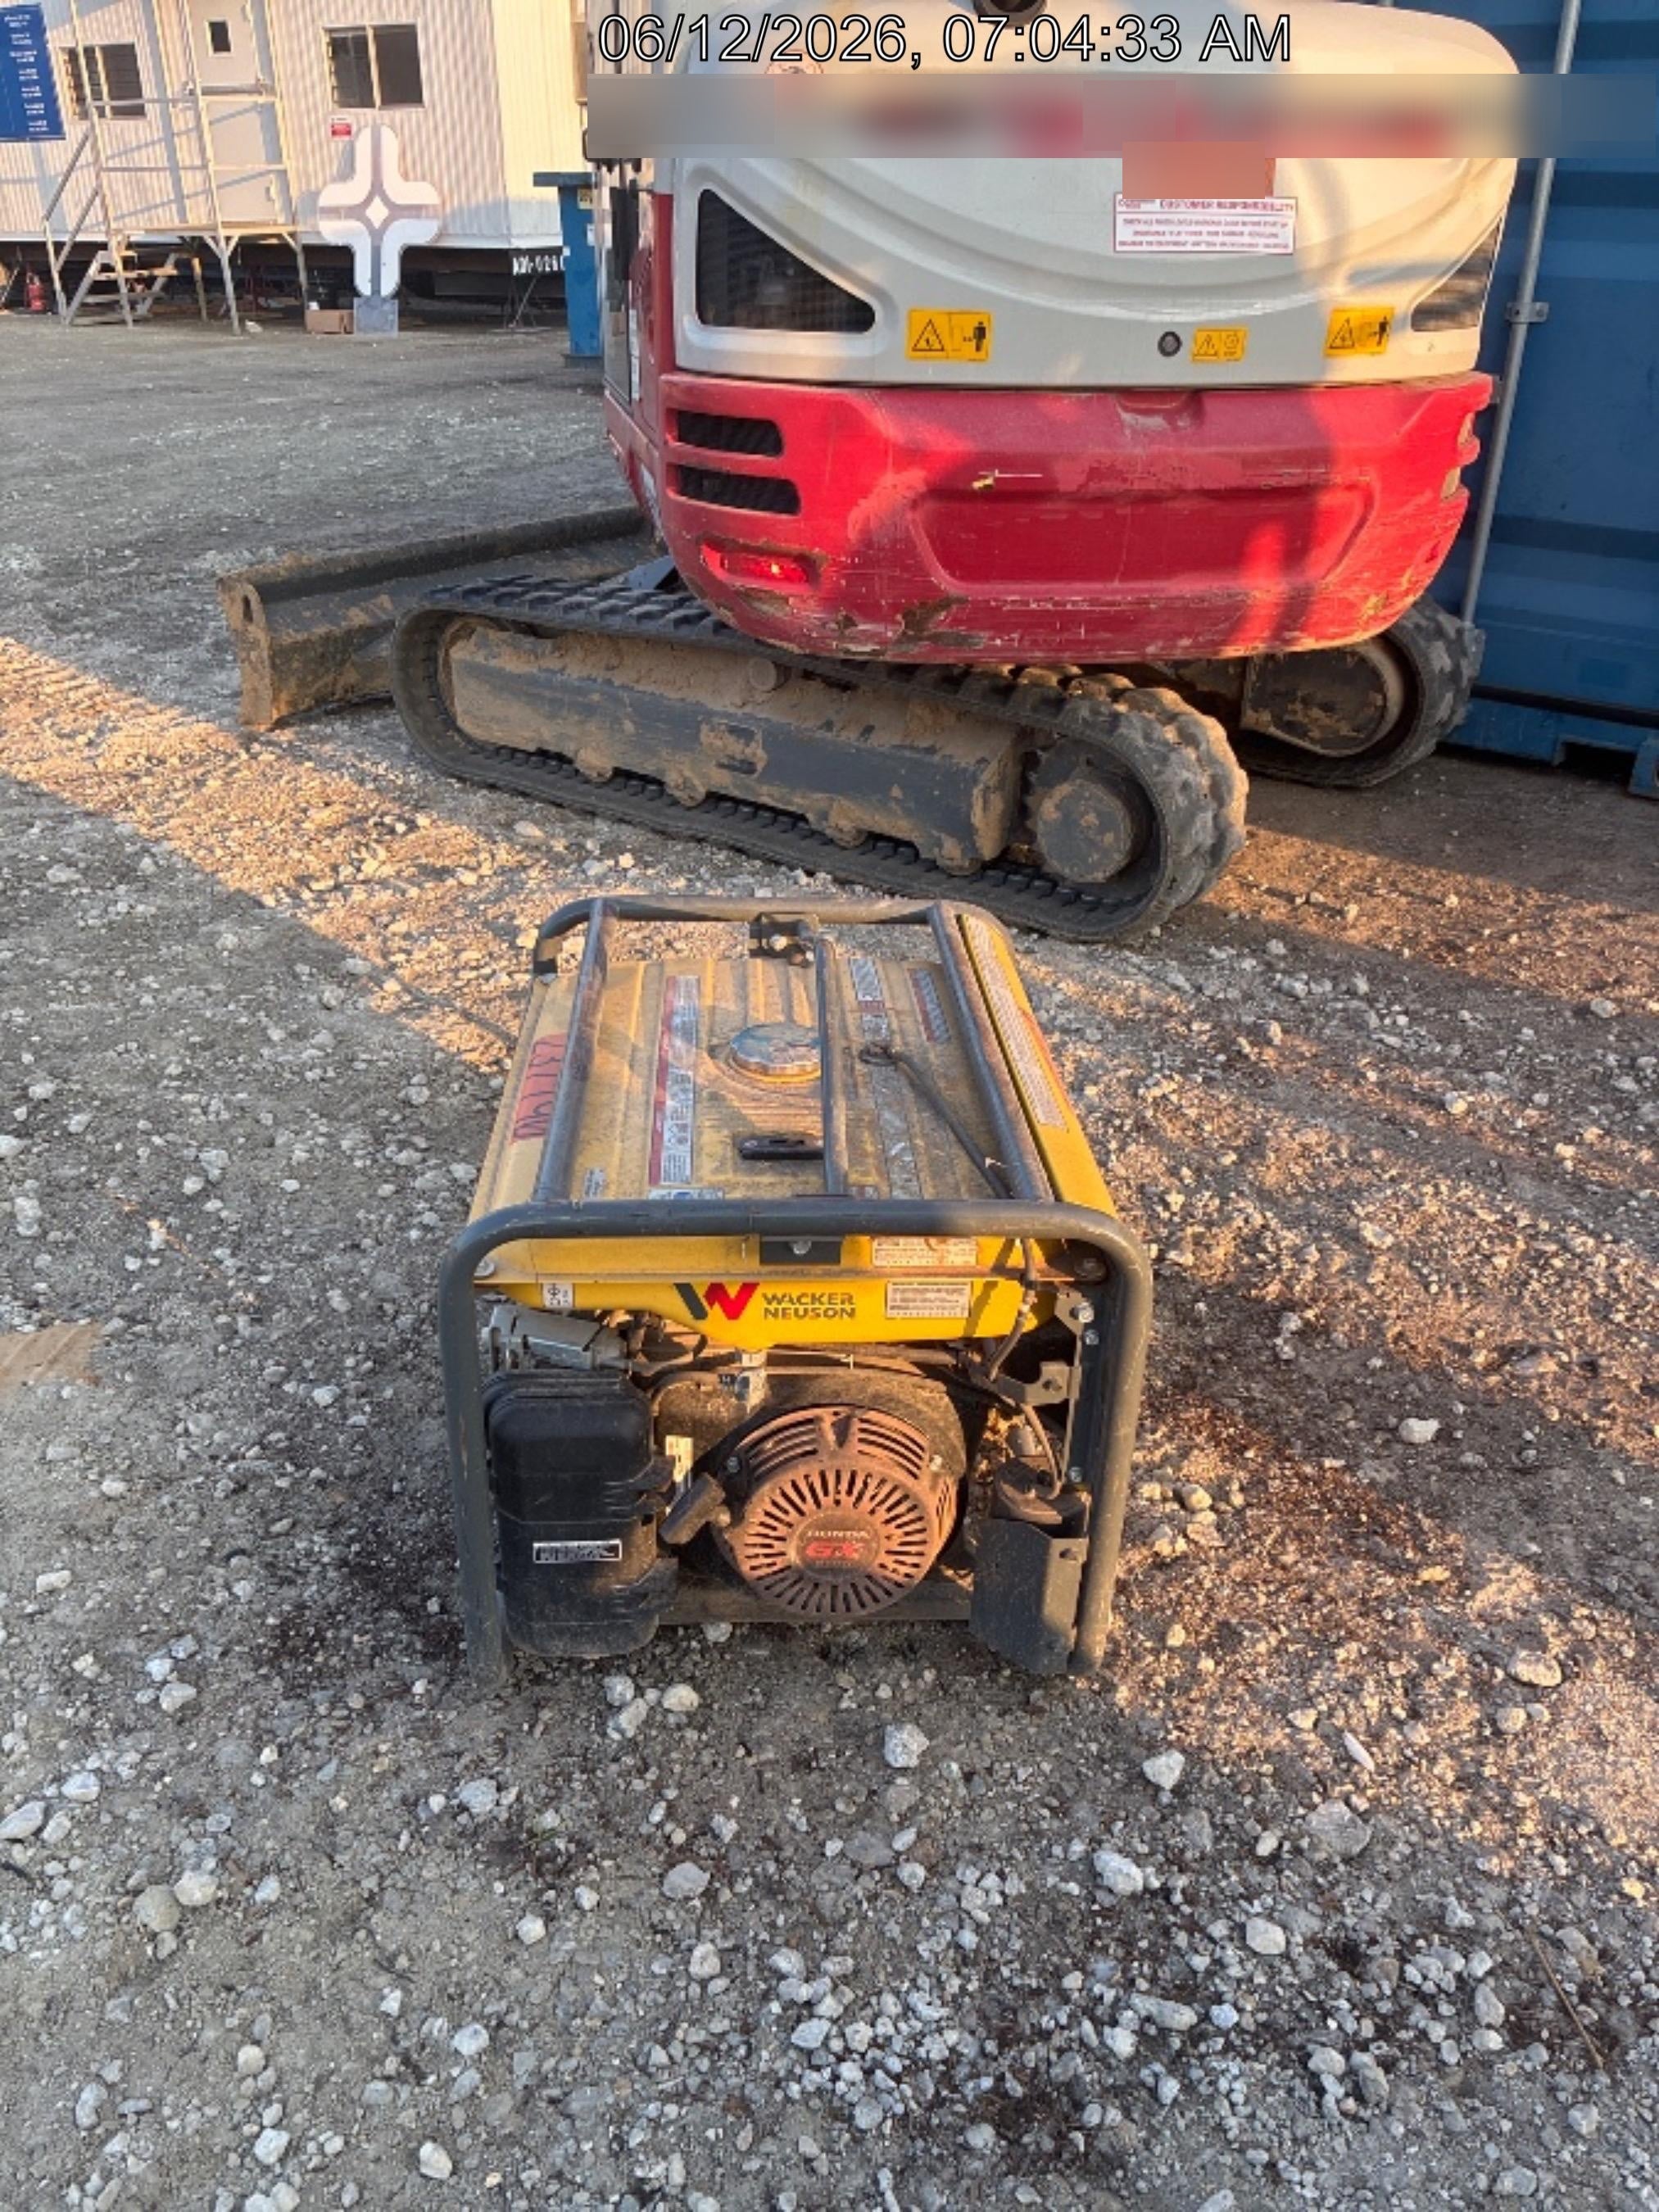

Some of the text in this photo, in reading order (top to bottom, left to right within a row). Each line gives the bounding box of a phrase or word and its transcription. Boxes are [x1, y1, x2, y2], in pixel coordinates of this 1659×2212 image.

[762, 1292, 854, 1306] WACKER
[763, 1307, 856, 1320] NEUSON
[807, 1530, 870, 1539] HONDA
